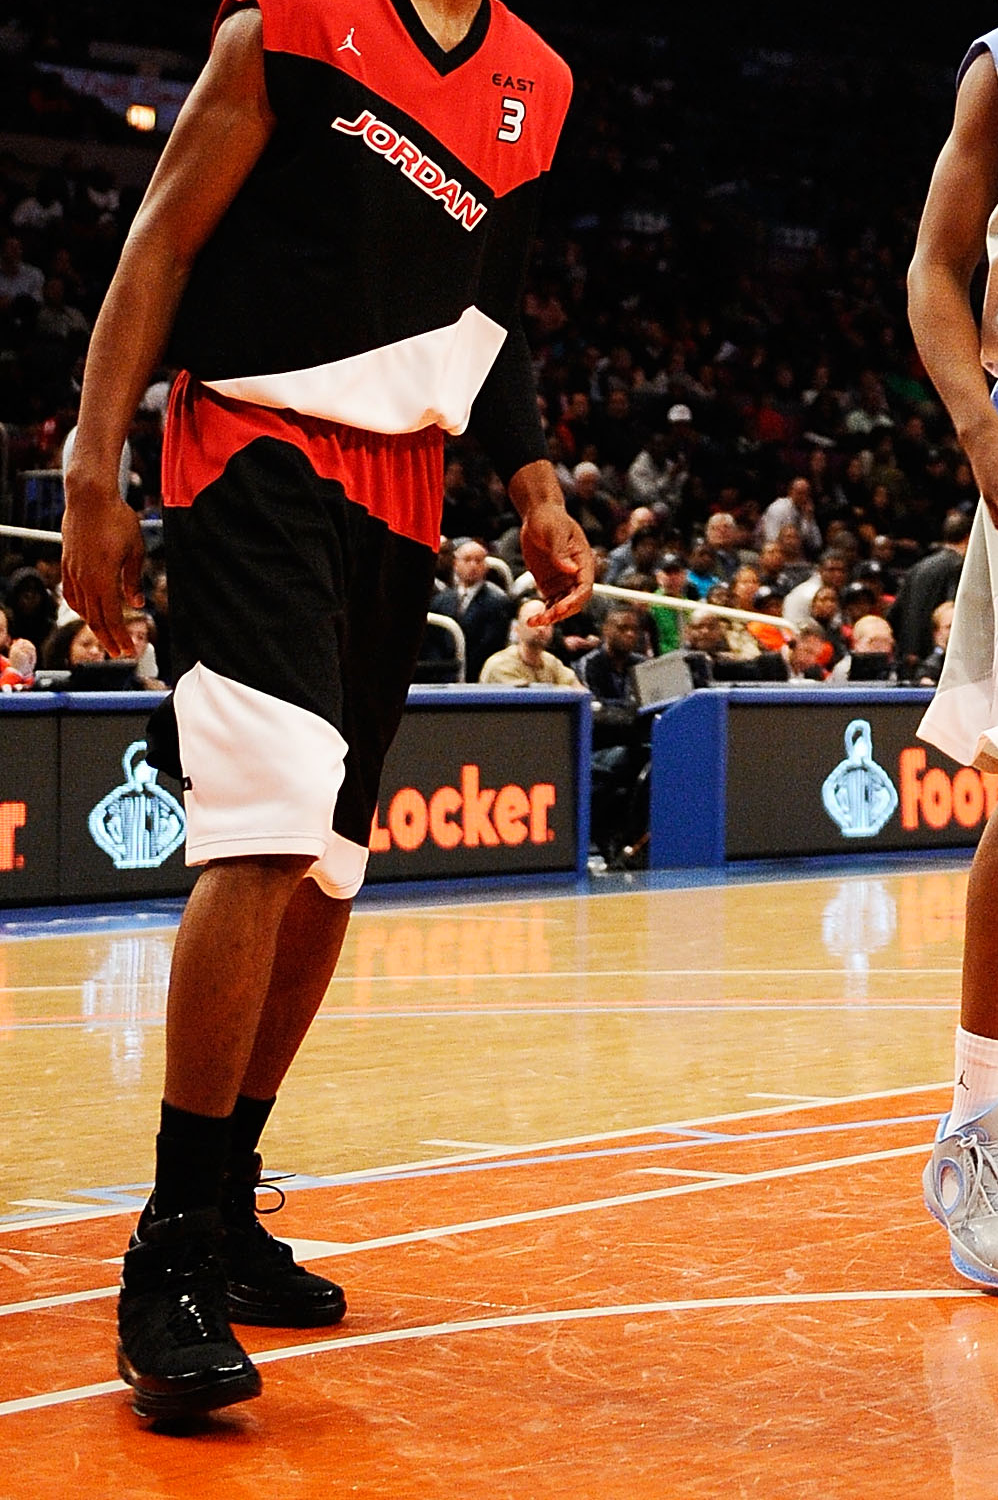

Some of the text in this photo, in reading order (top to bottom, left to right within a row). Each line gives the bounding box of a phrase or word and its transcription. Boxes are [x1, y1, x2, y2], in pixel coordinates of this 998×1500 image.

[492, 73, 535, 93] EAST
[496, 96, 526, 143] 3
[331, 109, 488, 232] JORDAN
